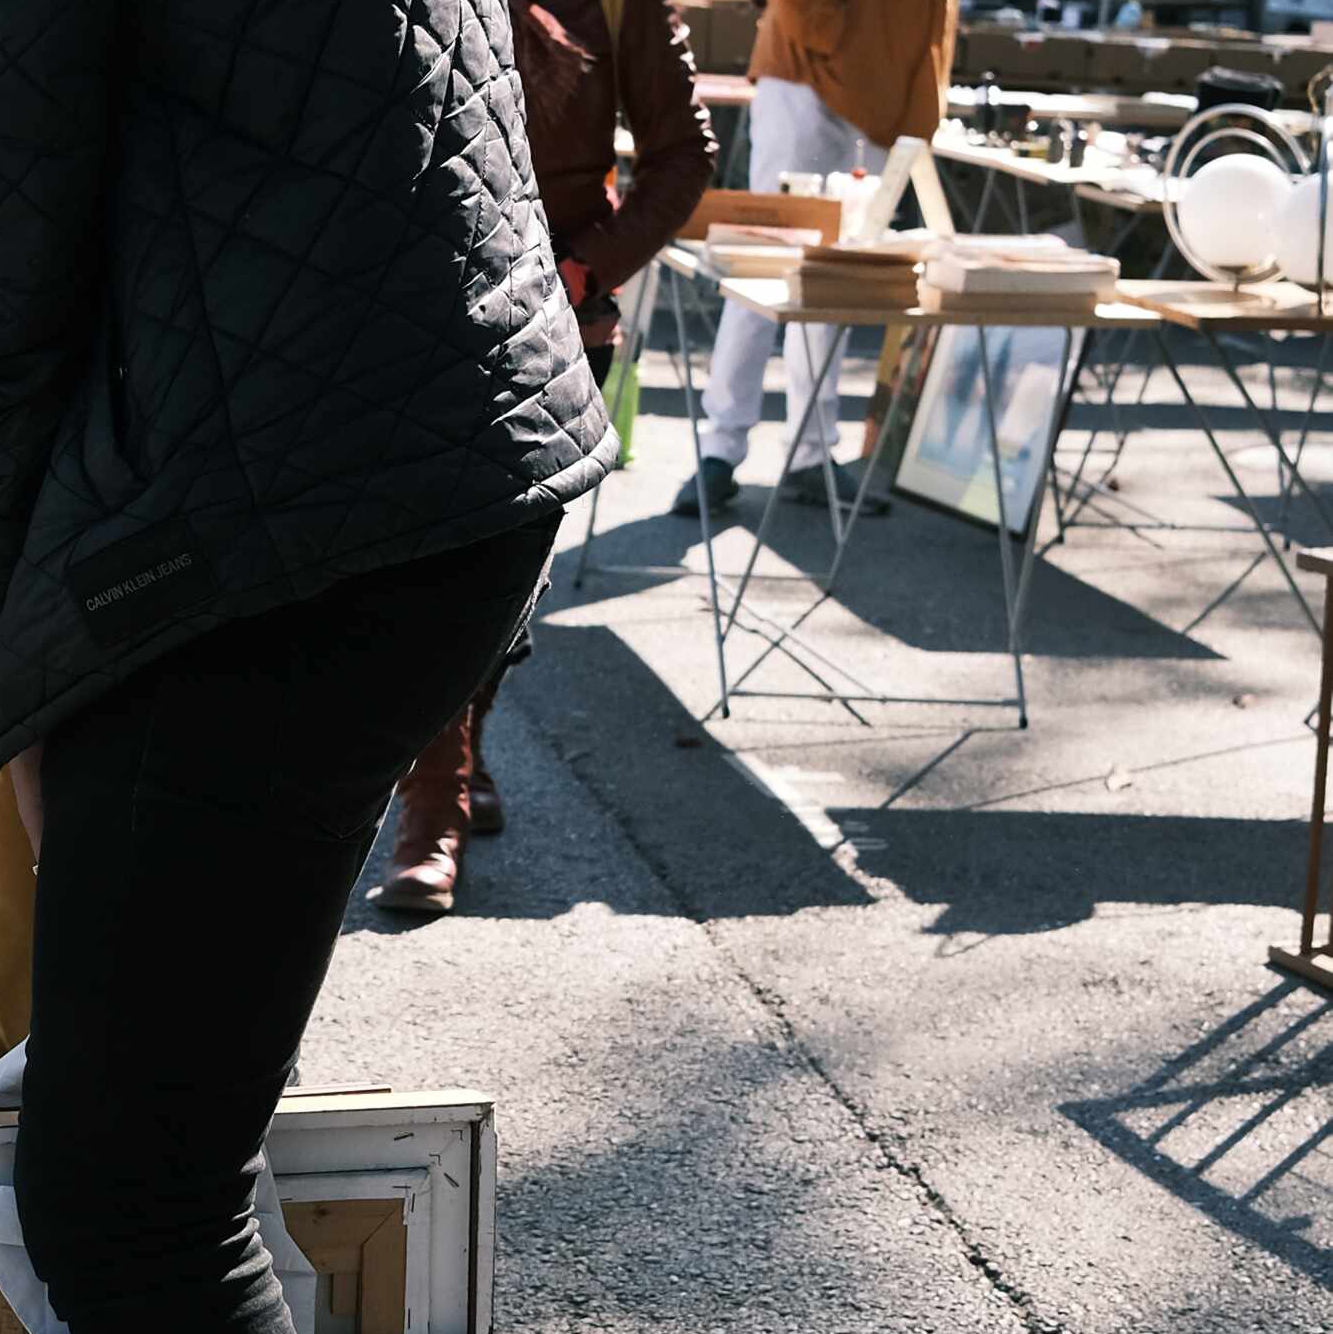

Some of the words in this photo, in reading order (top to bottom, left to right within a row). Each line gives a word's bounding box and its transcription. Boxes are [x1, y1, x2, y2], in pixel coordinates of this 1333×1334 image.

[86, 585, 124, 611] CALVIN
[122, 570, 156, 595] KLEIN
[154, 553, 192, 579] JEANS
